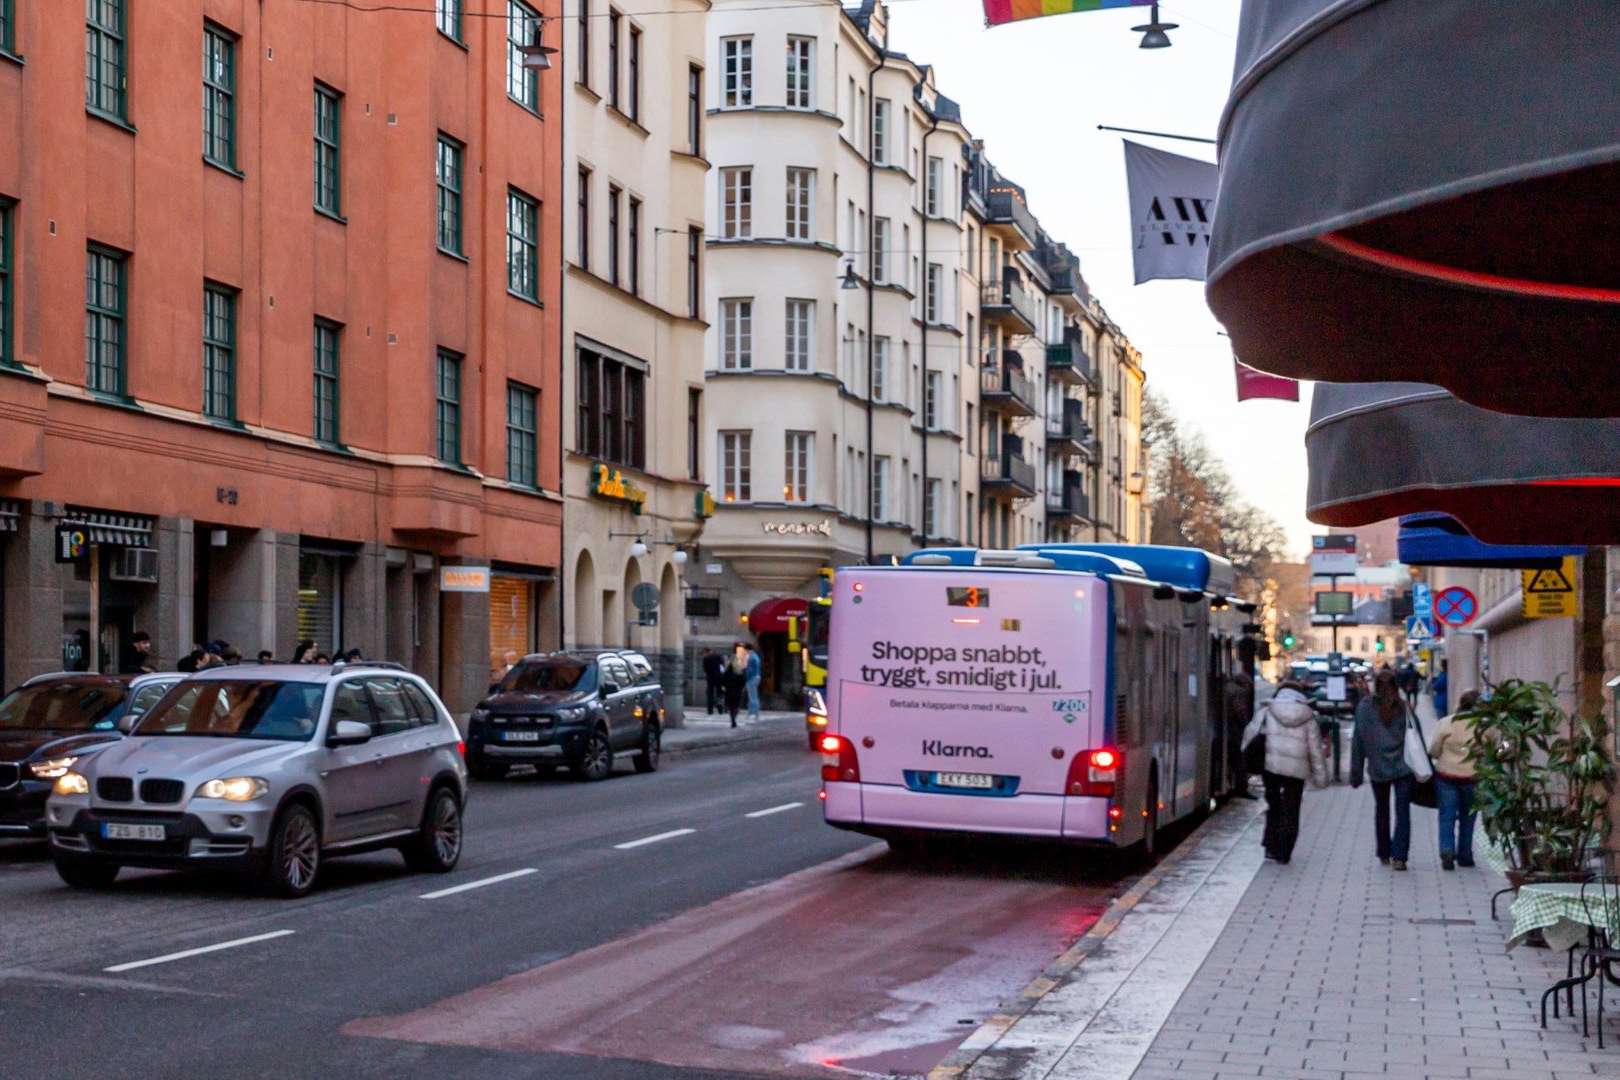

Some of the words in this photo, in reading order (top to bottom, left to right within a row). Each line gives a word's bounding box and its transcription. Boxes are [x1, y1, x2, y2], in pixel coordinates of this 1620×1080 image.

[965, 586, 979, 608] 3
[871, 641, 956, 665] Shoppa
[962, 645, 1047, 667] snabbt,
[861, 664, 931, 688] tryggt,
[936, 666, 1016, 691] smidigt
[1021, 668, 1027, 688] i
[1028, 669, 1062, 692] jul.
[889, 698, 920, 709] Betala
[921, 700, 969, 711] klapparna
[971, 703, 993, 712] med
[1052, 700, 1088, 712] 7200
[922, 739, 993, 759] Klarna.
[940, 773, 962, 785] EKY
[965, 774, 989, 786] 503
[108, 824, 131, 837] FZS
